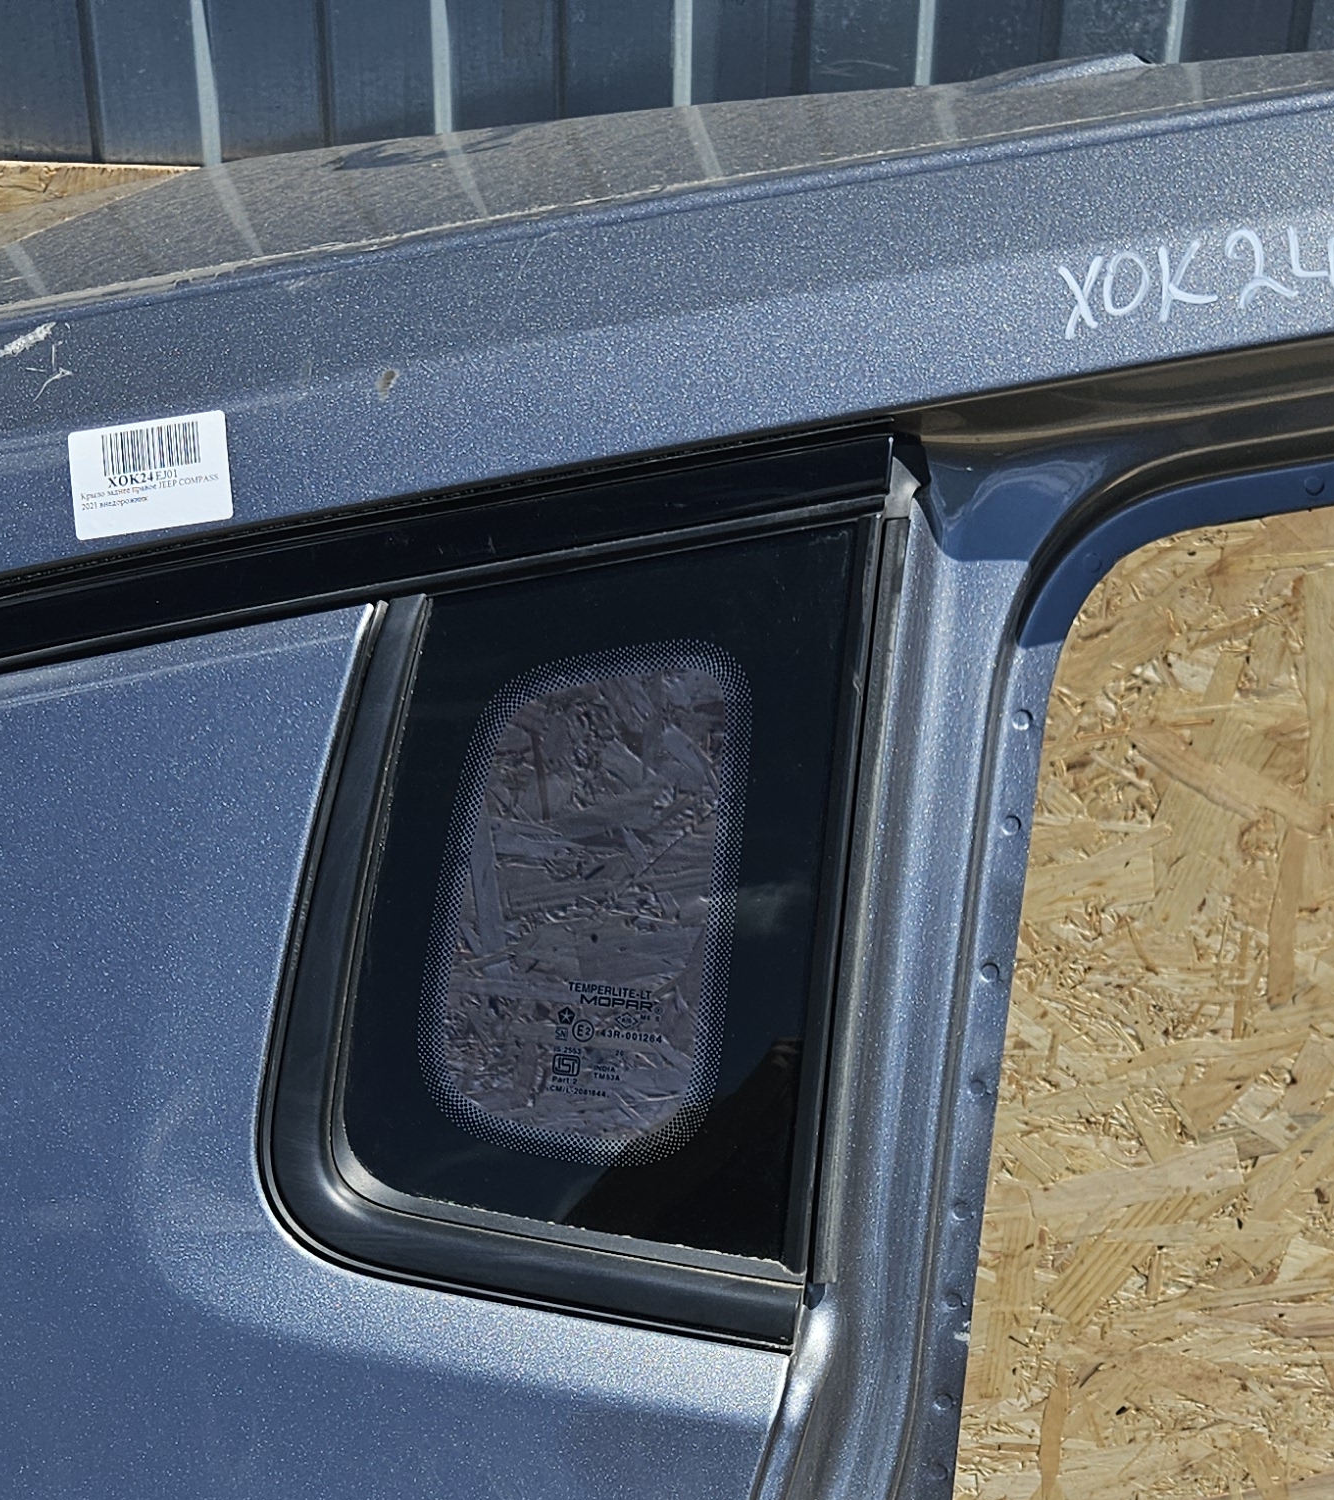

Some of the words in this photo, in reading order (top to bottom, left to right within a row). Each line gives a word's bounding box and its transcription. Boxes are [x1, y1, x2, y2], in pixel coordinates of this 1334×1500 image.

[159, 479, 178, 489] JEEP
[179, 473, 219, 486] COMPASS
[81, 501, 98, 511] 2021
[568, 981, 653, 1000] TEMPERLITE-LT
[580, 994, 654, 1013] MOPAR
[594, 1064, 616, 1073] INDIA
